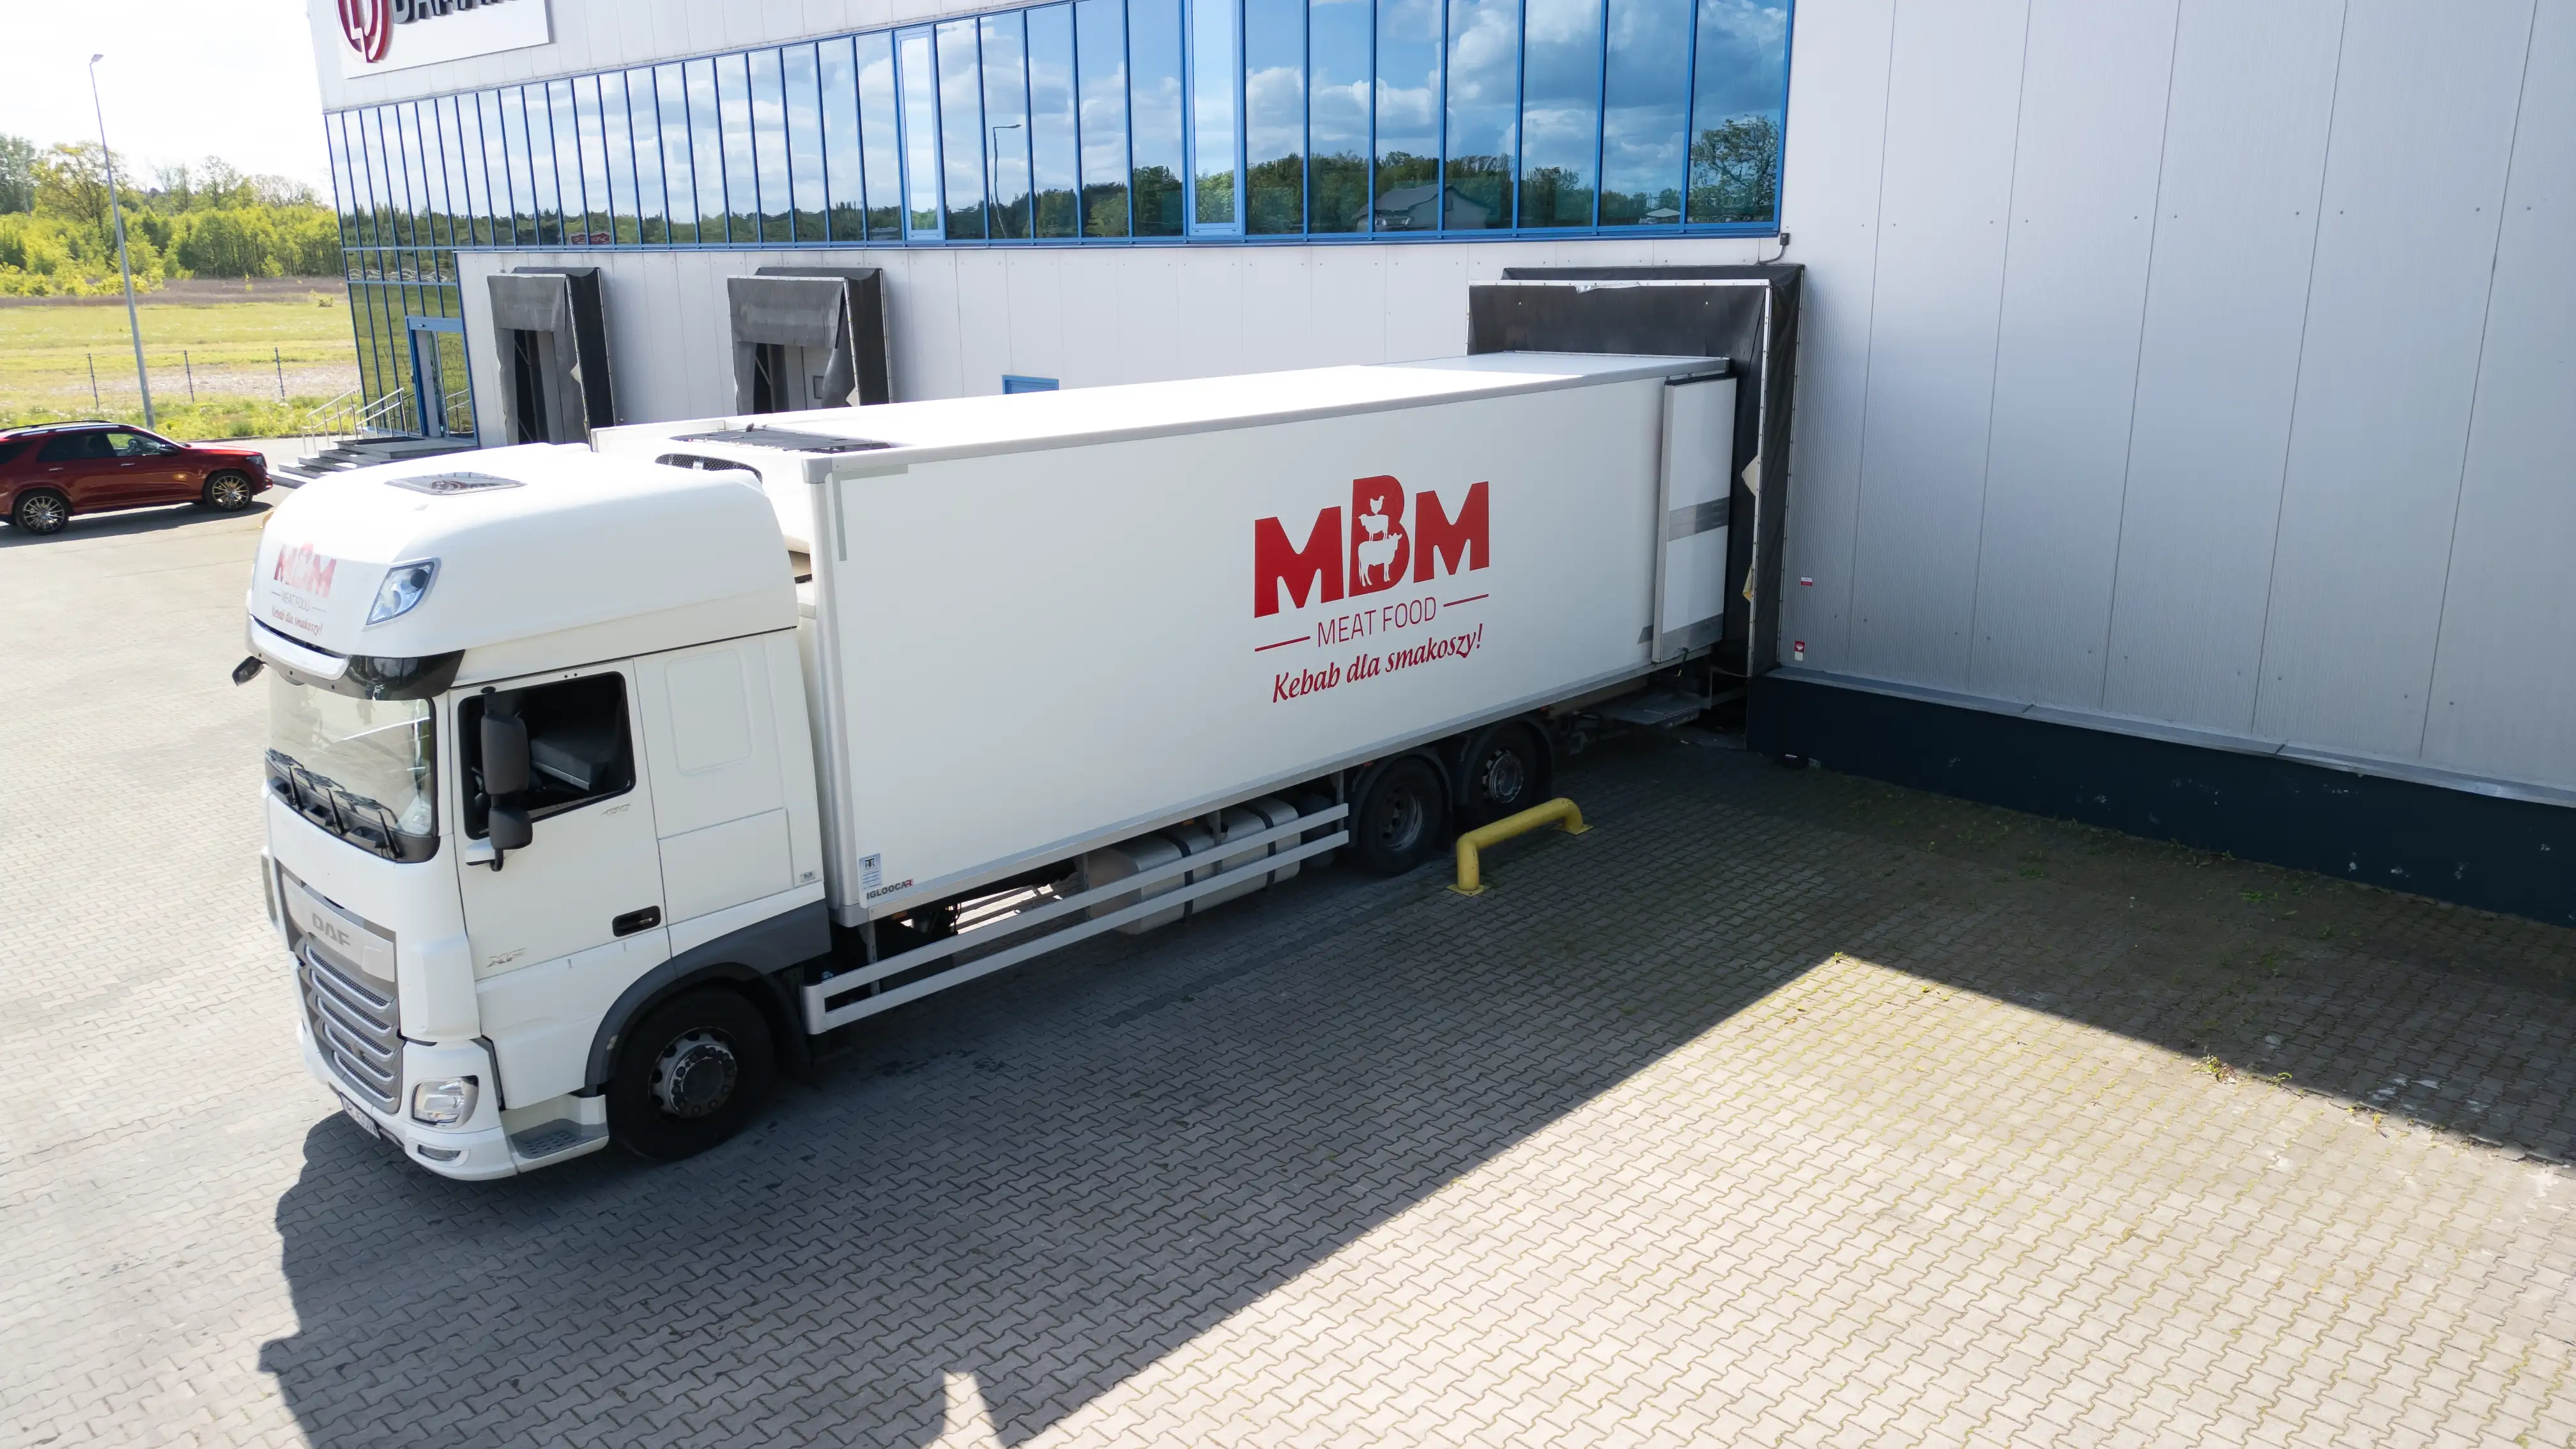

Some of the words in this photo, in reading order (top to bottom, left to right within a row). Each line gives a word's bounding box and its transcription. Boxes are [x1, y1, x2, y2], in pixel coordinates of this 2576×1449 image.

[1254, 475, 1489, 618] MBM
[1317, 609, 1377, 648] MEAT
[1383, 596, 1436, 632] FOOD
[1273, 661, 1340, 703] Kebab
[1346, 653, 1381, 684] dla
[1384, 623, 1483, 673] smakoszy!
[866, 878, 914, 900] IGLOOCAR
[312, 912, 351, 946] DAF
[486, 947, 527, 968] XF
